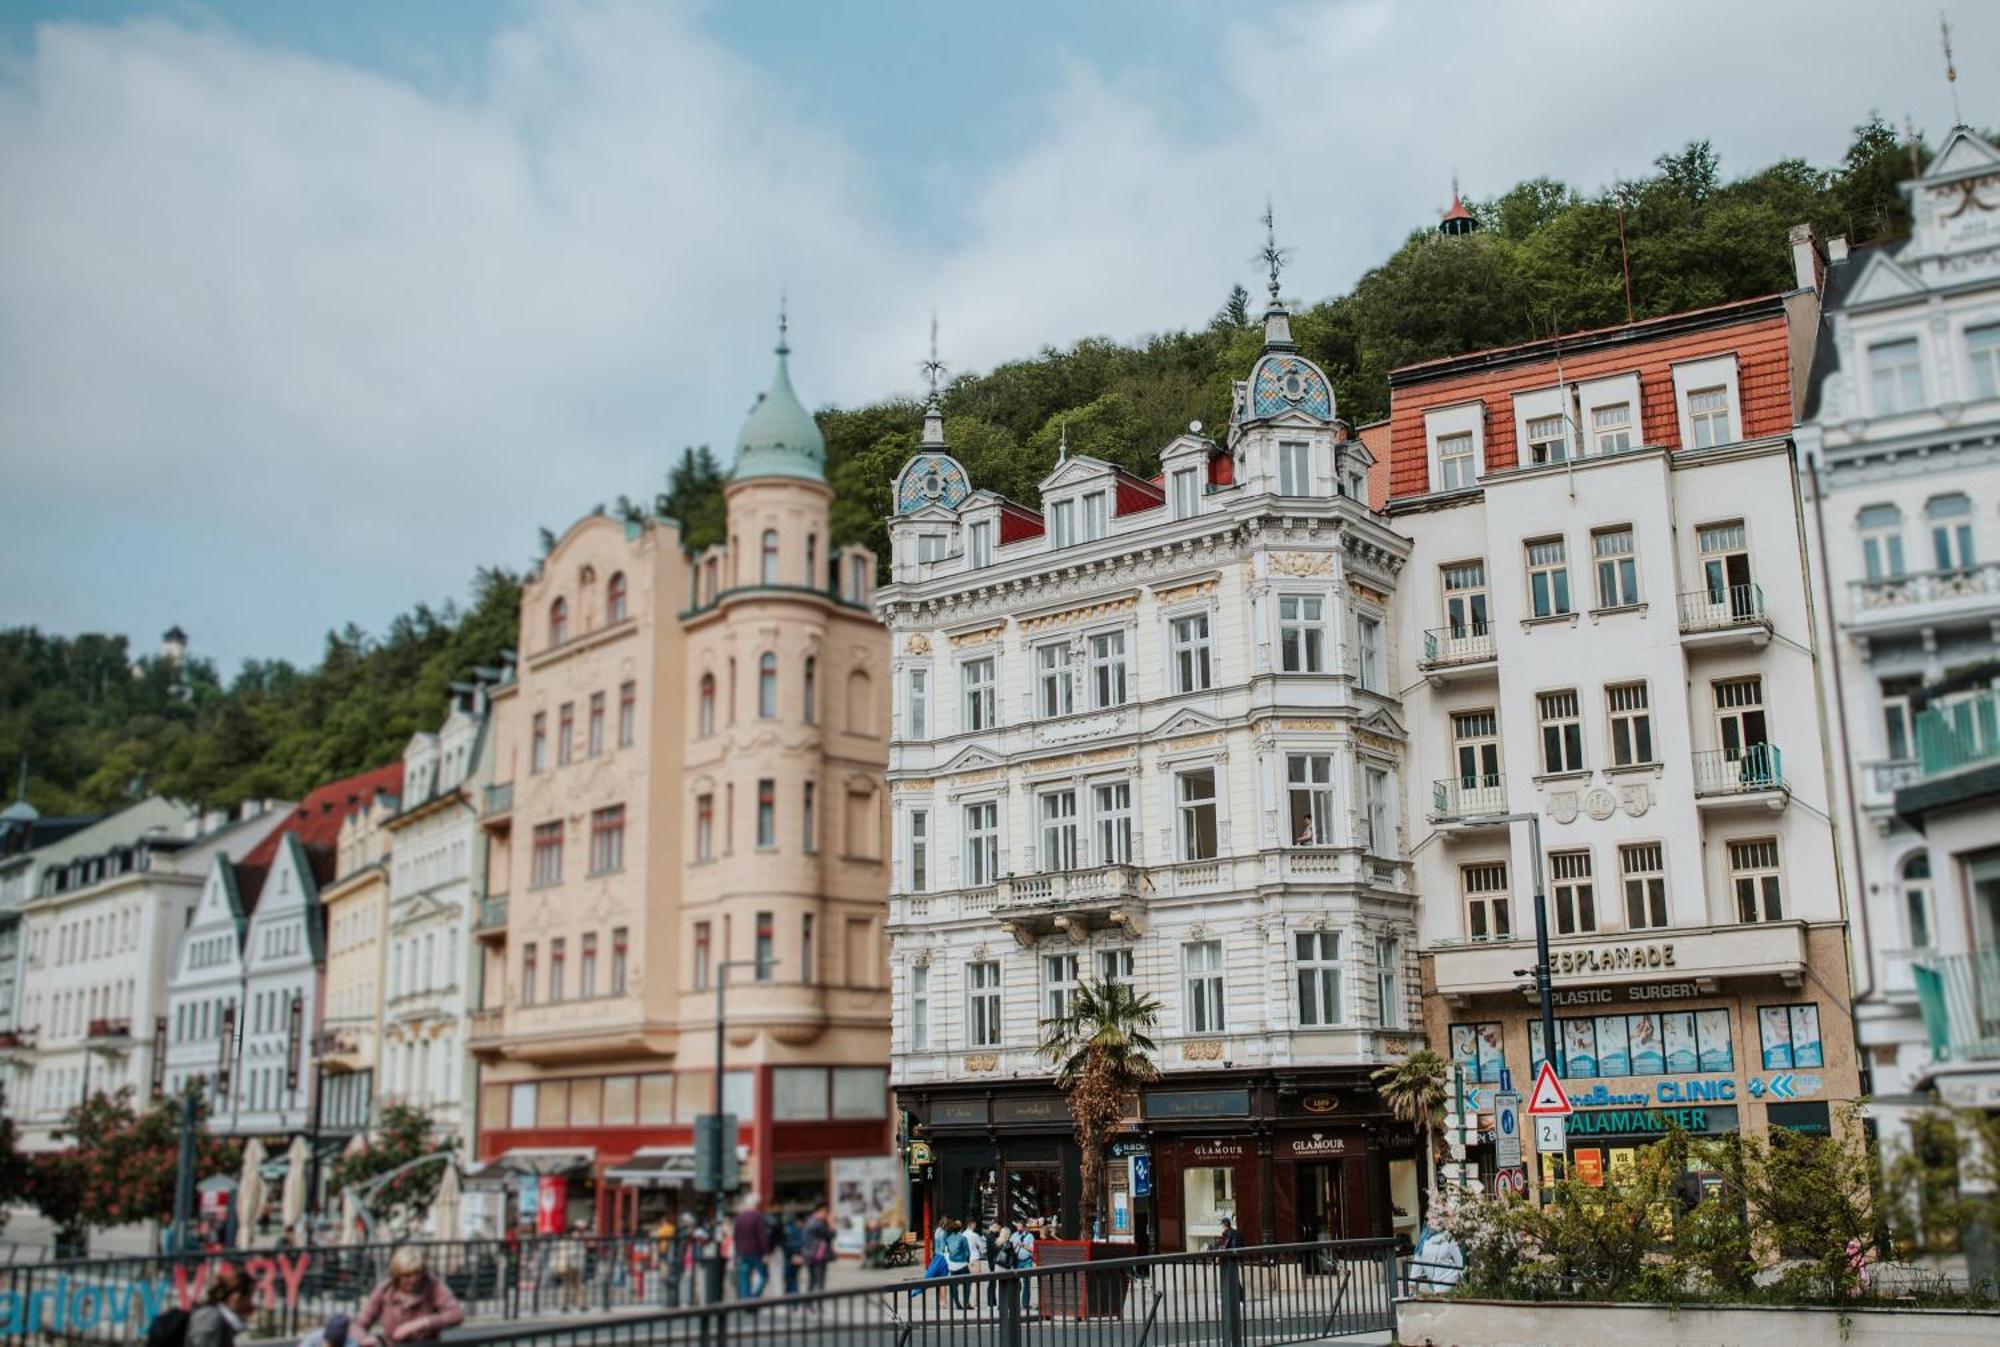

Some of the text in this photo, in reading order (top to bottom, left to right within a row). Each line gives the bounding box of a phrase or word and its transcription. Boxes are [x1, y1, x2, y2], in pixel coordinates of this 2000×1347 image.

[1549, 944, 1676, 974] ESPLANADE
[1551, 983, 1701, 1005] PLASTIC SURGERY
[1655, 1079, 1737, 1103] CLINIC
[1194, 1145, 1243, 1155] GLAMOUR
[1292, 1139, 1345, 1151] GLAMOUR
[173, 1252, 310, 1311] VRY
